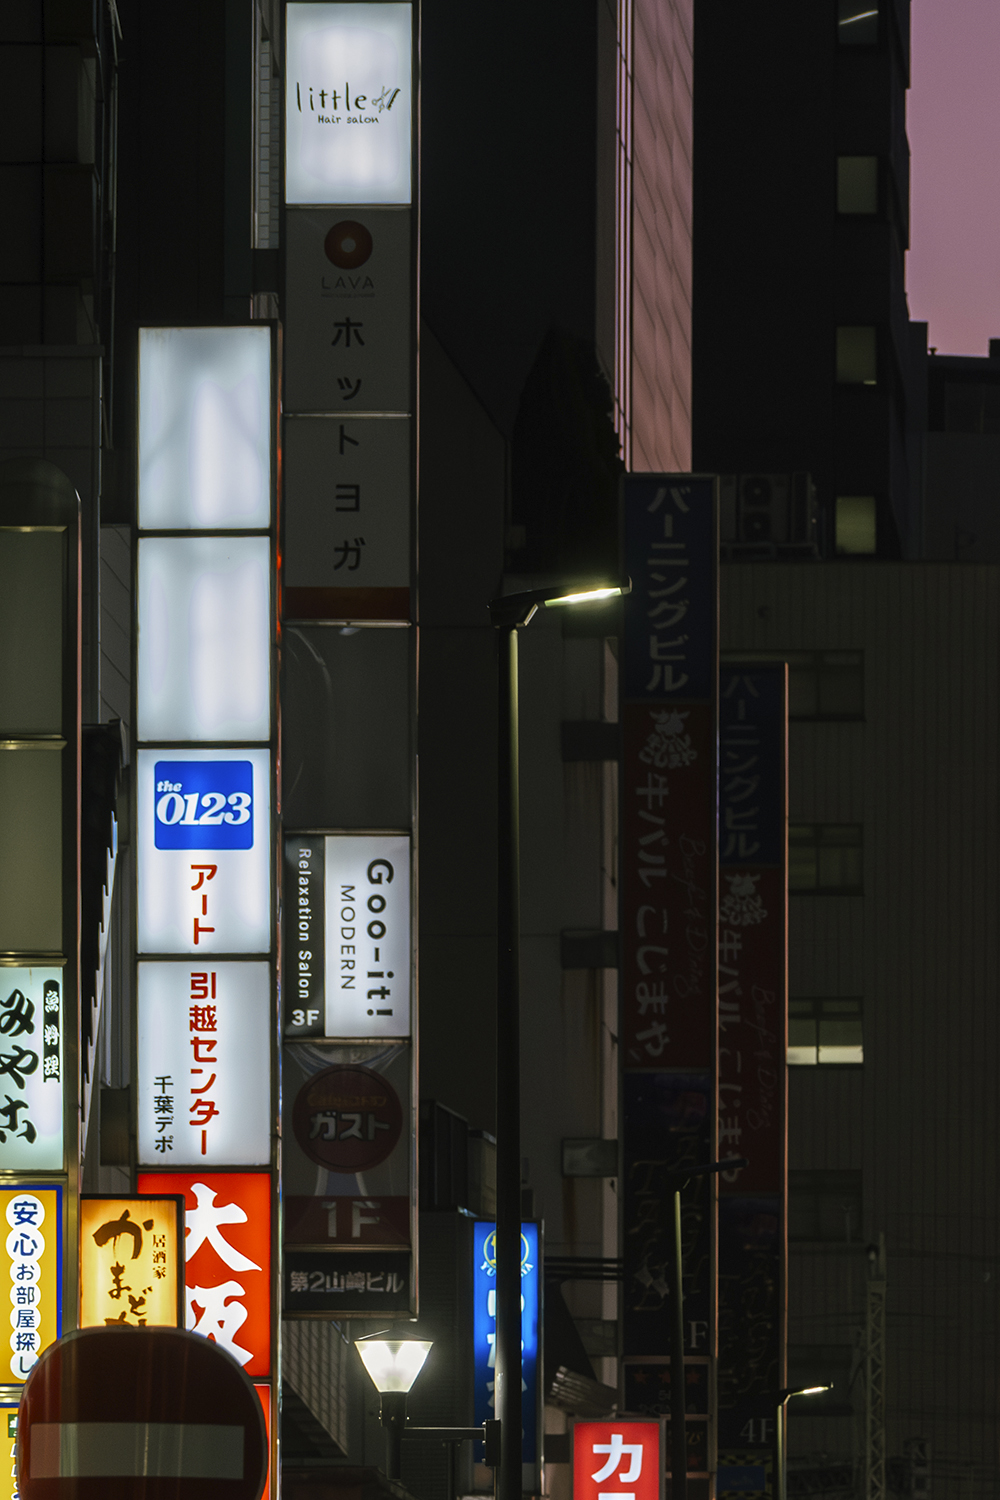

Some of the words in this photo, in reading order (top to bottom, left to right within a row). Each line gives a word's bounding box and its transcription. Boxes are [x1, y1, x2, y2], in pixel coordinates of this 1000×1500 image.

[296, 81, 366, 112] little
[317, 115, 342, 125] Hair
[346, 115, 379, 125] salon
[321, 275, 374, 288] LAVA
[332, 317, 366, 570] ホットヨガ
[646, 487, 690, 693] バーニングビル
[157, 780, 183, 794] the
[156, 793, 251, 826] 0123
[190, 864, 218, 945] アート
[298, 848, 312, 942] Relaxation
[340, 885, 355, 991] MODERN
[367, 857, 395, 1018] Goo-it!
[298, 949, 312, 999] Salon
[291, 1008, 319, 1027] 3F
[188, 971, 220, 1156] 引越センター
[154, 1076, 174, 1154] 千葉デポ
[309, 1110, 391, 1142] ガスト
[322, 1200, 381, 1238] 1F
[13, 1200, 38, 1374] 安心お部屋探し
[290, 1271, 404, 1294] 第2山崎ビル
[740, 1418, 774, 1444] 4F
